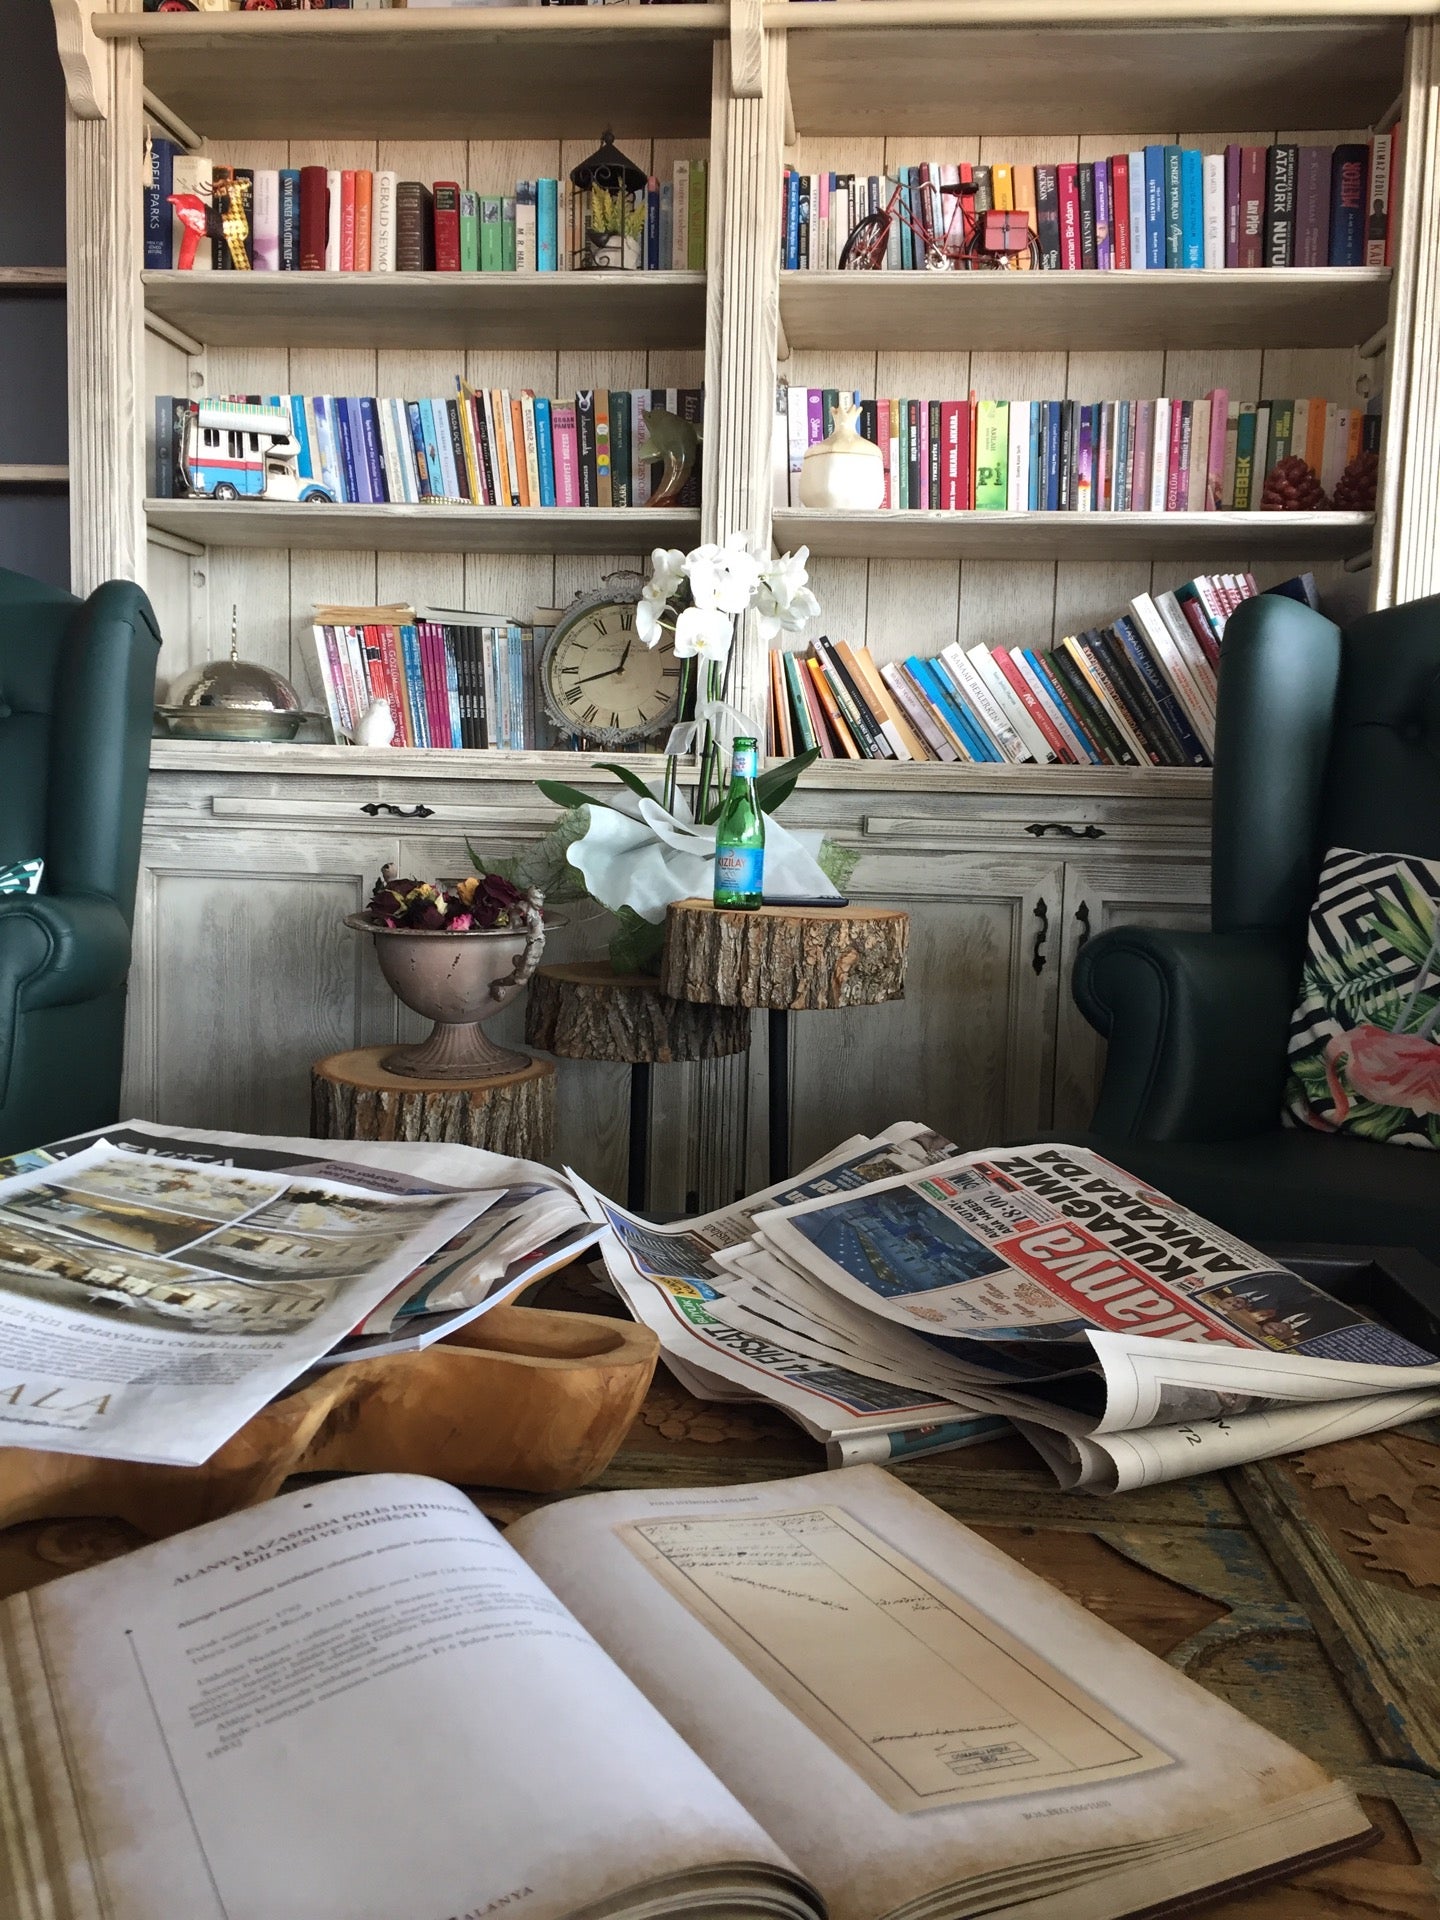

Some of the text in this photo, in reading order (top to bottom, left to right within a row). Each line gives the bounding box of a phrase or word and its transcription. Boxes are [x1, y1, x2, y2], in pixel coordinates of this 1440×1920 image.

[150, 152, 160, 191] ADELE
[1038, 169, 1047, 201] JACKSON
[1046, 176, 1054, 192] LISA
[1341, 163, 1361, 208] METEOR
[1374, 141, 1386, 198] YILMAZ ÖZDİL
[150, 193, 160, 230] PARKS
[283, 177, 293, 260] EIN BILD VON EINEM MANN
[379, 177, 391, 227] GERALD
[1065, 200, 1075, 225] Adam
[1170, 187, 1180, 220] MOURAD
[1246, 200, 1260, 235] BAY PİPO
[1272, 149, 1289, 268] ATATÜRK NUTU
[674, 207, 687, 252] weisberger
[1065, 226, 1075, 238] Bir
[517, 251, 525, 269] HALL
[450, 408, 458, 430] YOLDA
[1234, 456, 1251, 508] BEBEK
[663, 668, 680, 677] III
[1124, 623, 1162, 690] YAŞASIN HAYAT
[951, 653, 1001, 723] BABAMI BEKLERKEN
[1023, 693, 1037, 708] AŞK
[356, 1171, 399, 1184] yolunda
[951, 1203, 1001, 1239] Alper KUTAY
[963, 1198, 1014, 1233] ANA HABER
[982, 1194, 1029, 1223] 18:00
[990, 1156, 1204, 1282] KULAĞIMIZ
[1031, 1149, 1256, 1273] ANKARA'DA
[25, 1308, 285, 1350] için detaylara odaklandık
[701, 1325, 793, 1368] FIRSAT
[172, 1555, 241, 1587] ALANYA
[239, 1517, 343, 1559] KAZASINDA
[345, 1505, 389, 1525] POLİS
[233, 1510, 428, 1573] EDİLMESİ VE TAHSİSATI
